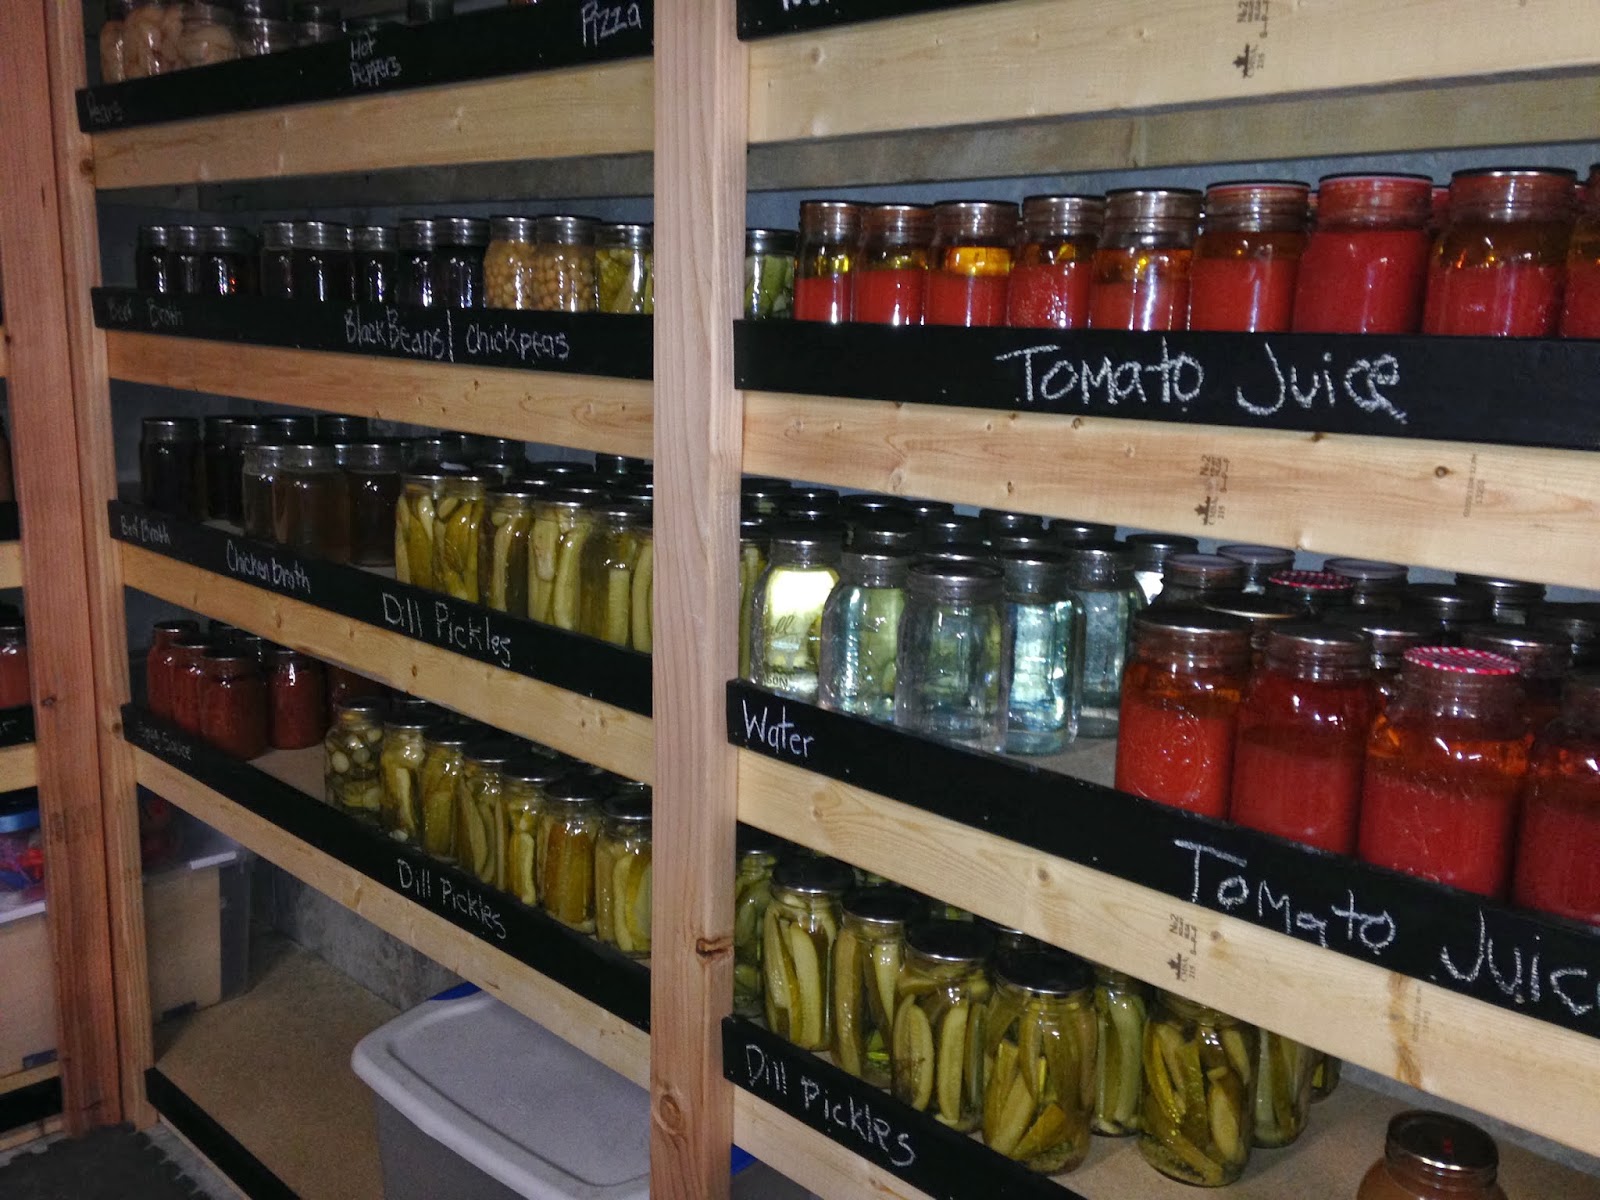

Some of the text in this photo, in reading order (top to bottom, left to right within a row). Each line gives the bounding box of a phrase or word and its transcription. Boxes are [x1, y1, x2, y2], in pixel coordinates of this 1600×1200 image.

[350, 31, 376, 60] Hot
[581, 0, 642, 47] Pizza
[344, 306, 386, 347] Black
[465, 322, 570, 361] Chickpeas
[995, 336, 1204, 405] Tomato
[227, 539, 270, 583] Chicken
[382, 592, 511, 668] Dill Pickles
[742, 699, 815, 758] Water
[397, 858, 507, 939] Dill Pickles
[1174, 839, 1396, 955] Tomato
[1440, 907, 1600, 1016] Juic
[745, 1043, 916, 1167] Dill Pickles
